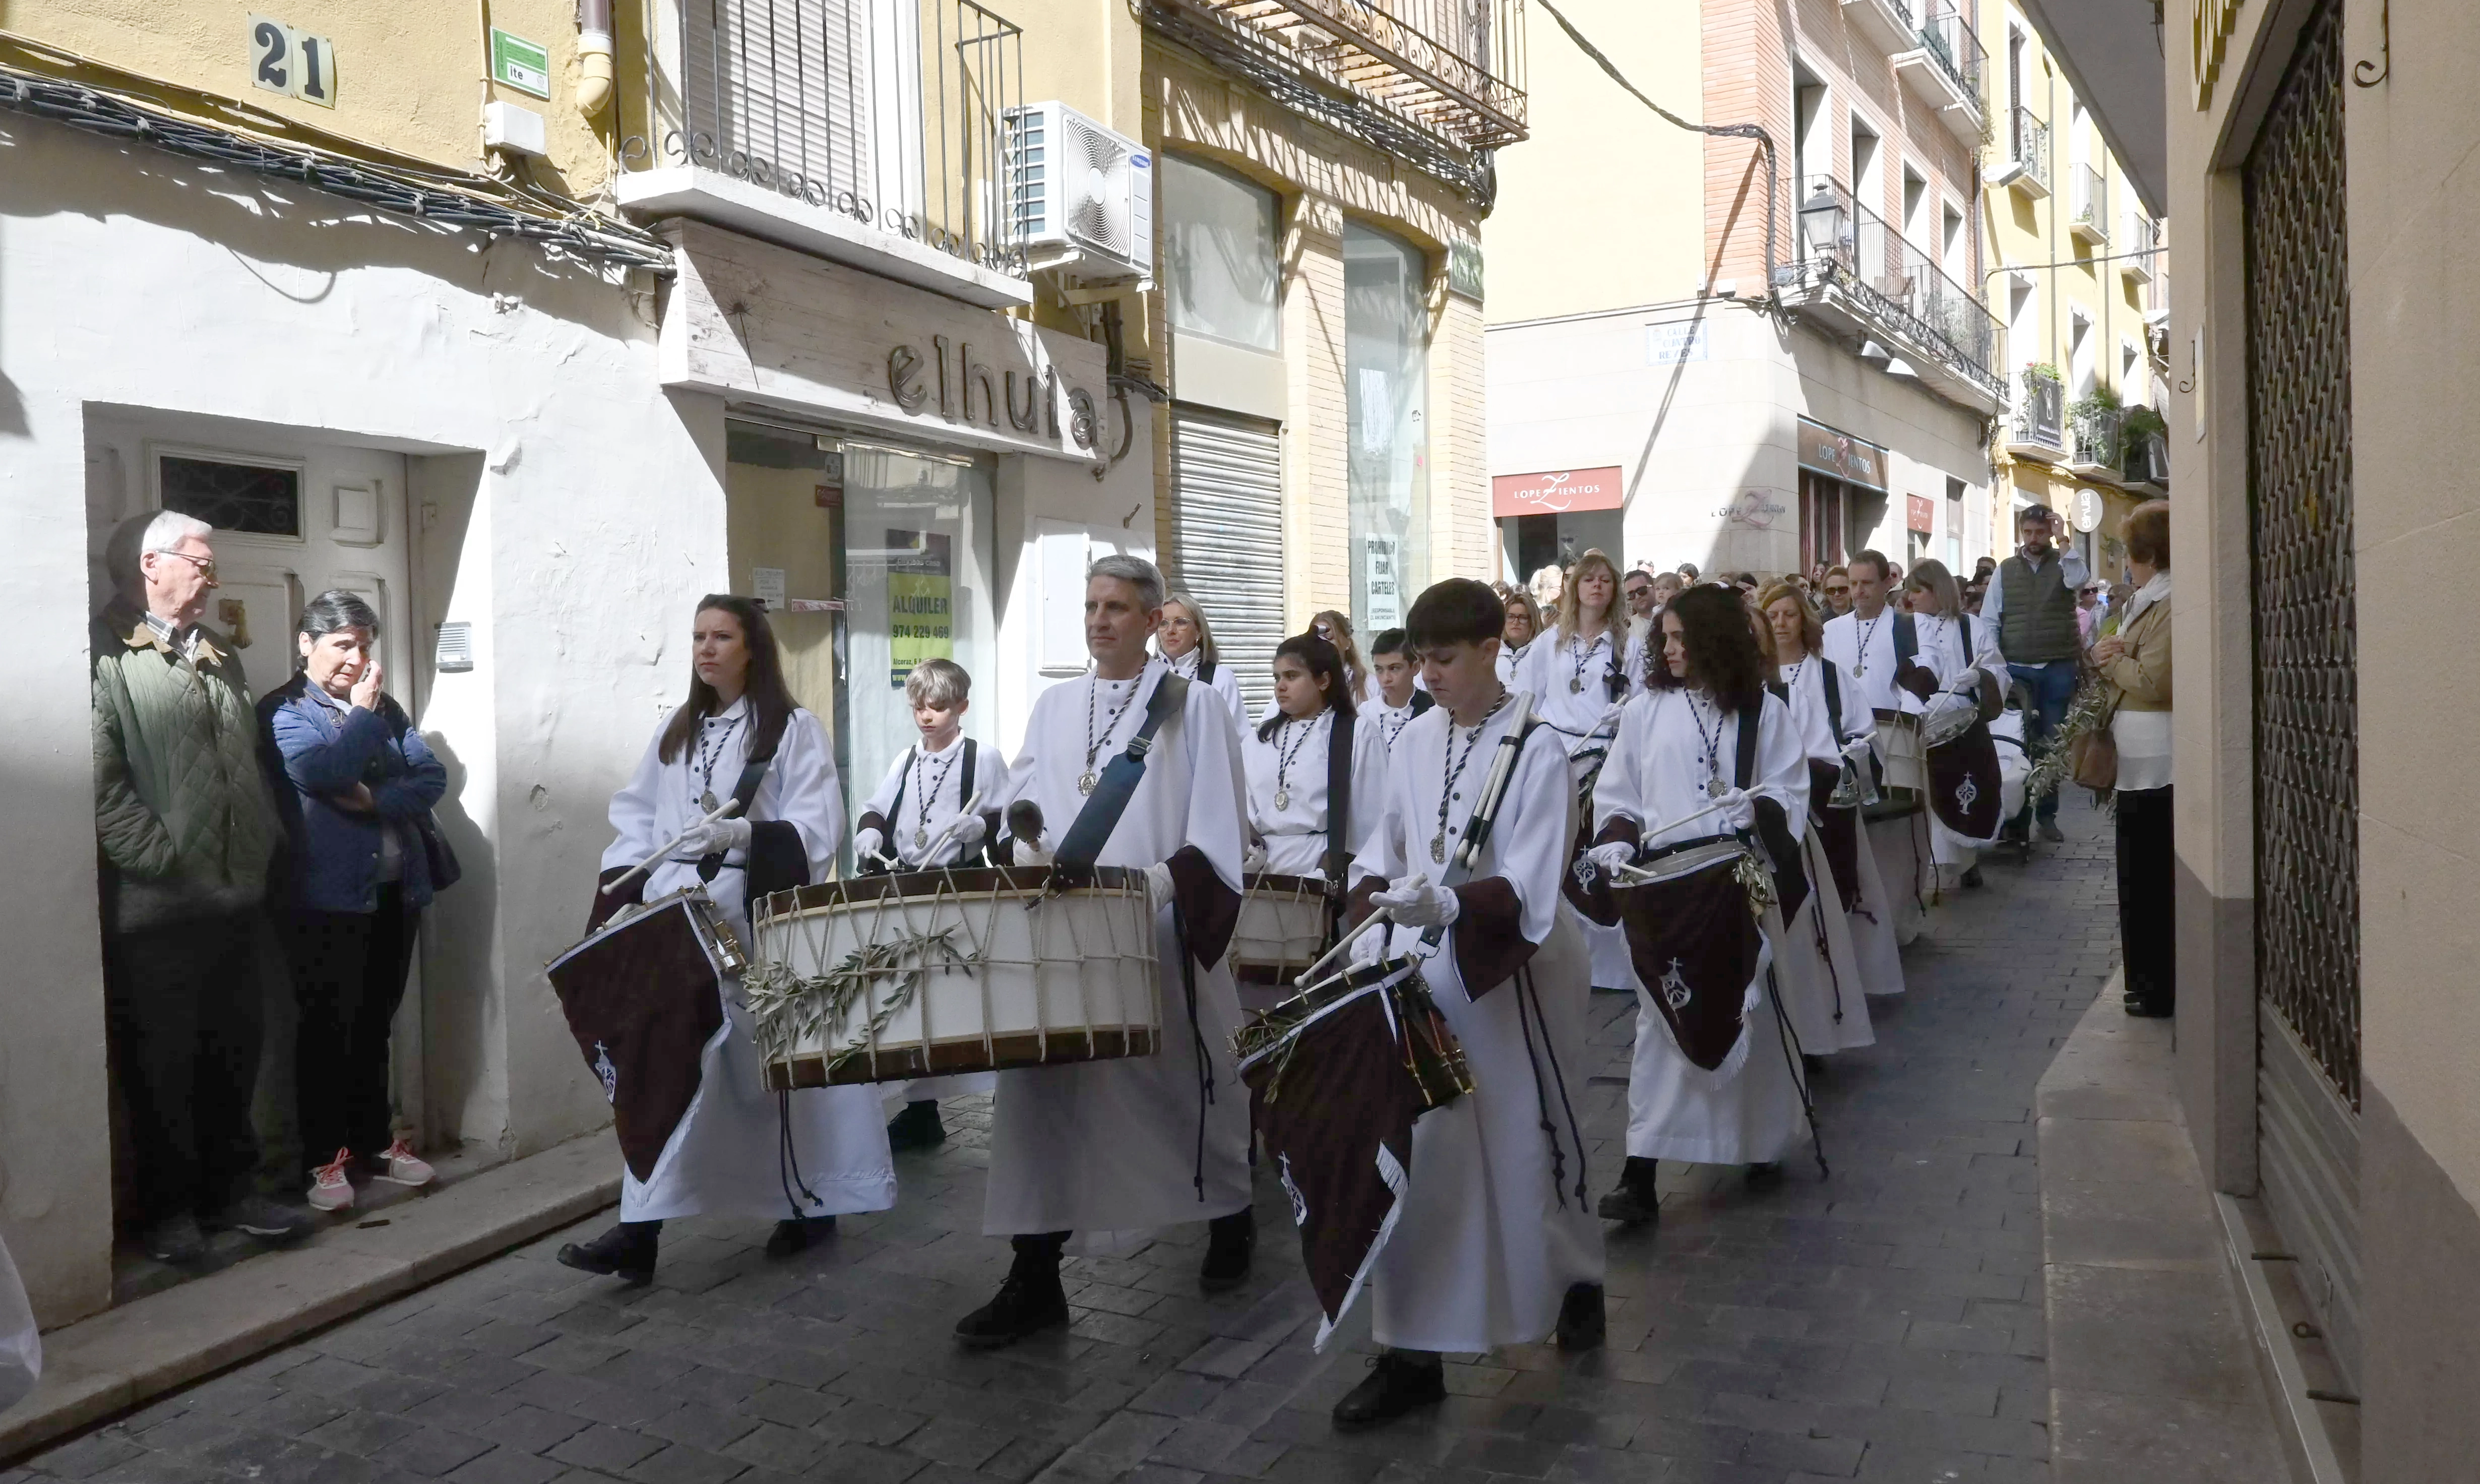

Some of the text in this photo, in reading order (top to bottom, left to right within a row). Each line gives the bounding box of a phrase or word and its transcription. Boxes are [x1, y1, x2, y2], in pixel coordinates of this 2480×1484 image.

[255, 22, 324, 100] 21
[510, 66, 523, 80] ite
[1667, 326, 1695, 337] CALLE
[1663, 336, 1701, 348] CUATRO
[1659, 348, 1694, 359] REYES
[888, 334, 1099, 451] elhula
[1375, 561, 1389, 575] FIJAR
[1371, 581, 1395, 595] CARTELES
[893, 595, 948, 614] ALQUILER
[893, 624, 949, 639] 974 229 469
